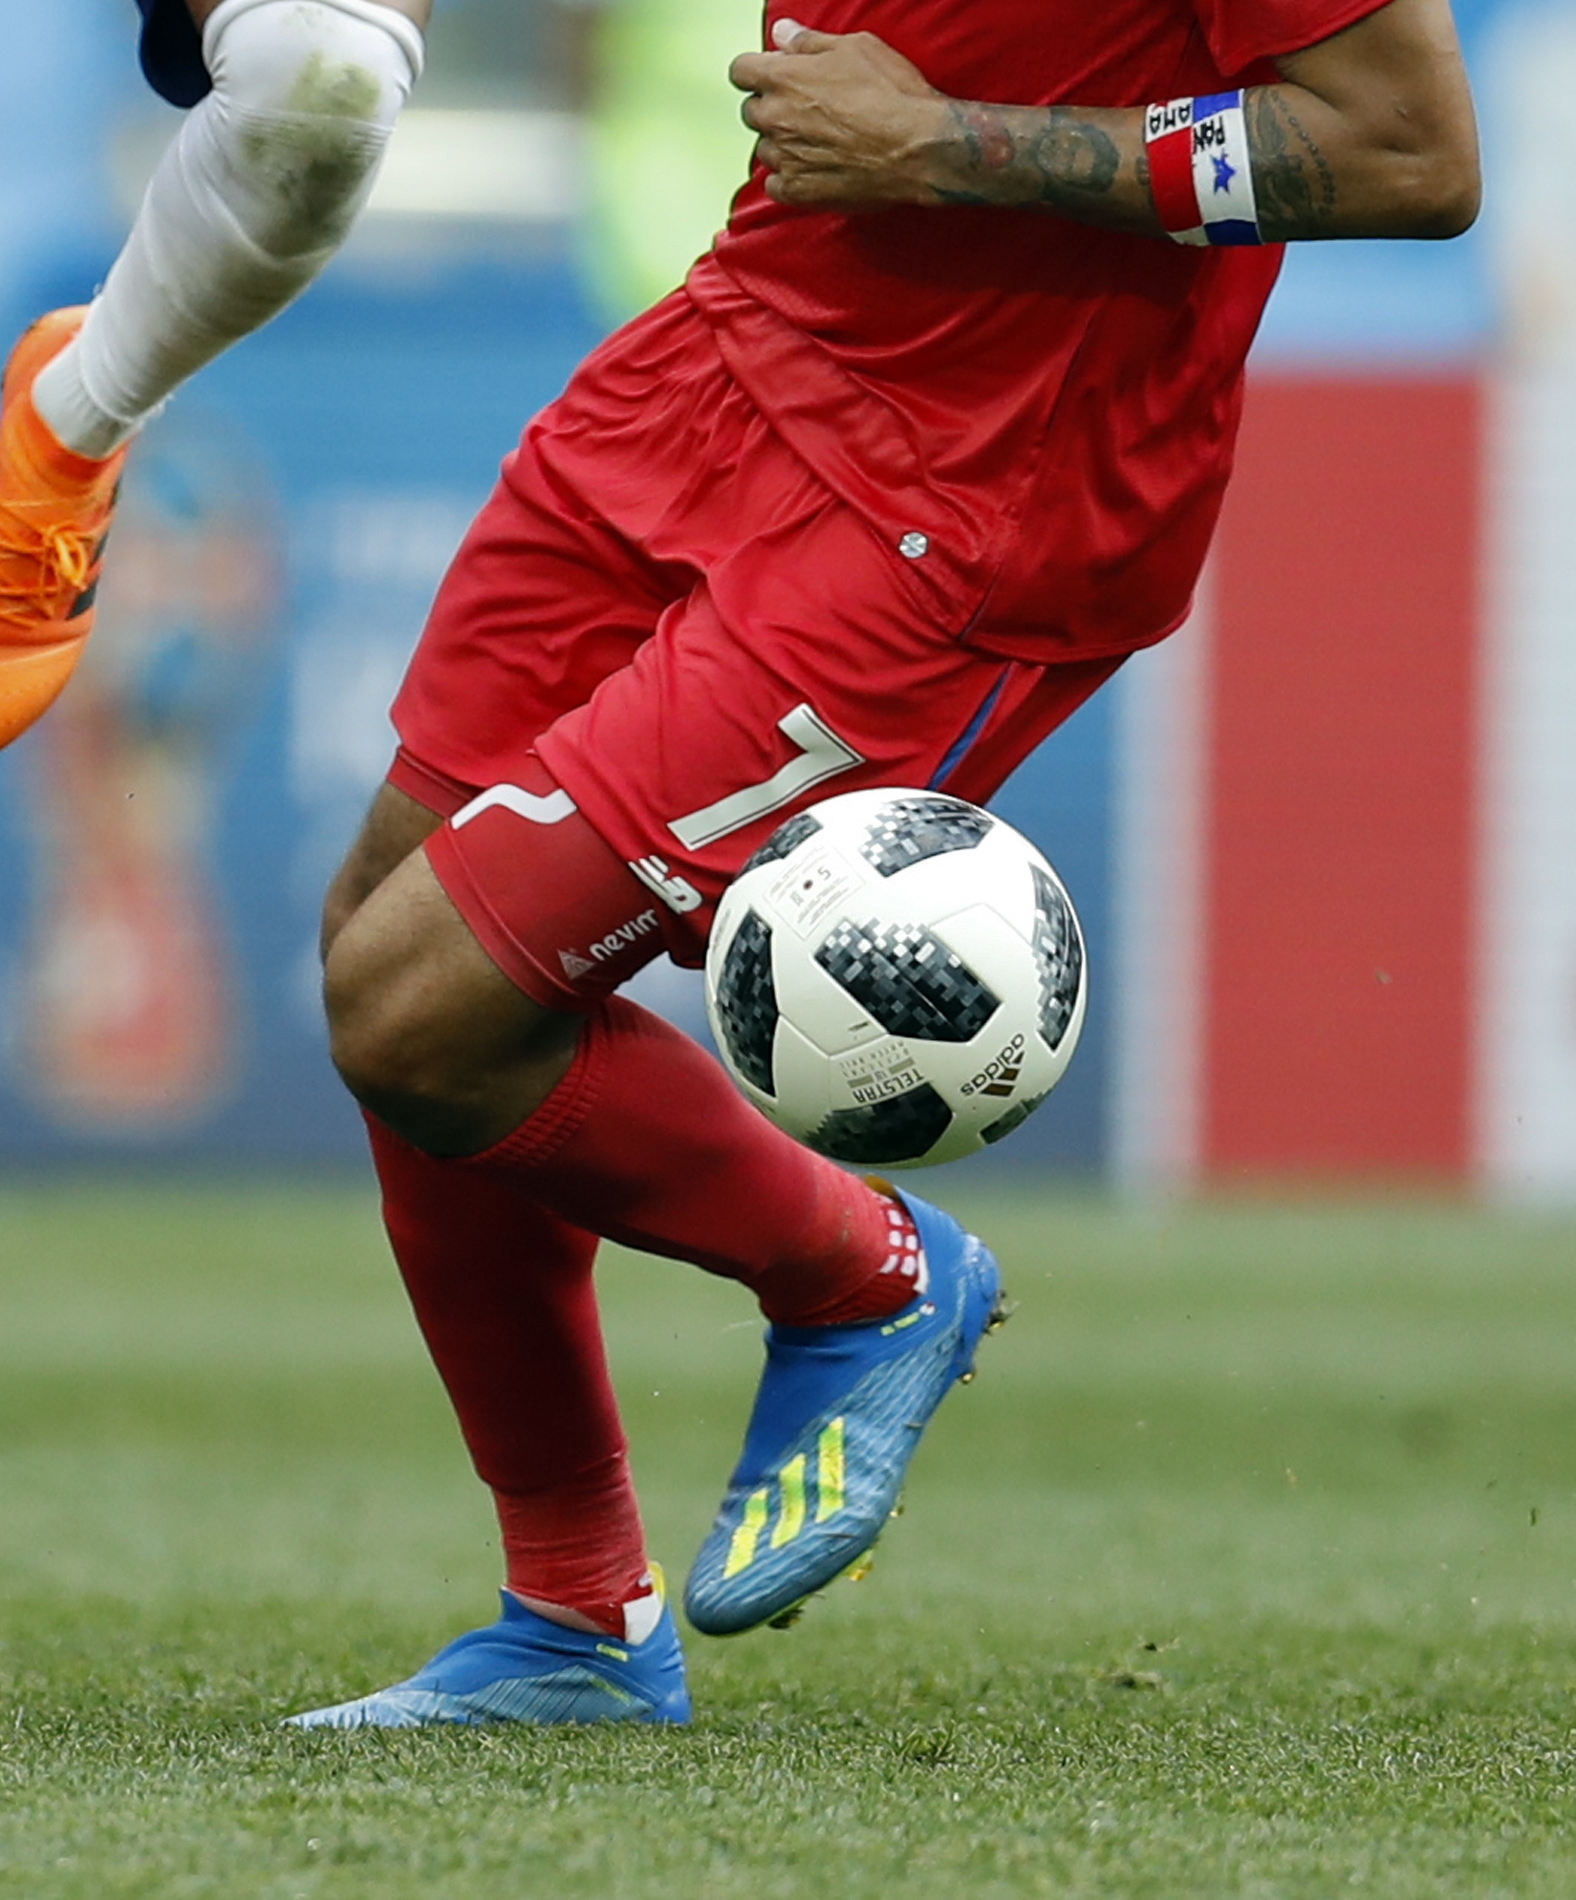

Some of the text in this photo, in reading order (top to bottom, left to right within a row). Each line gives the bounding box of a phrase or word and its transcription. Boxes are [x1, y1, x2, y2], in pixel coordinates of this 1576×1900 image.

[665, 701, 867, 852] 7
[852, 1068, 925, 1104] TELSTAR
[960, 1033, 1026, 1097] adidas
